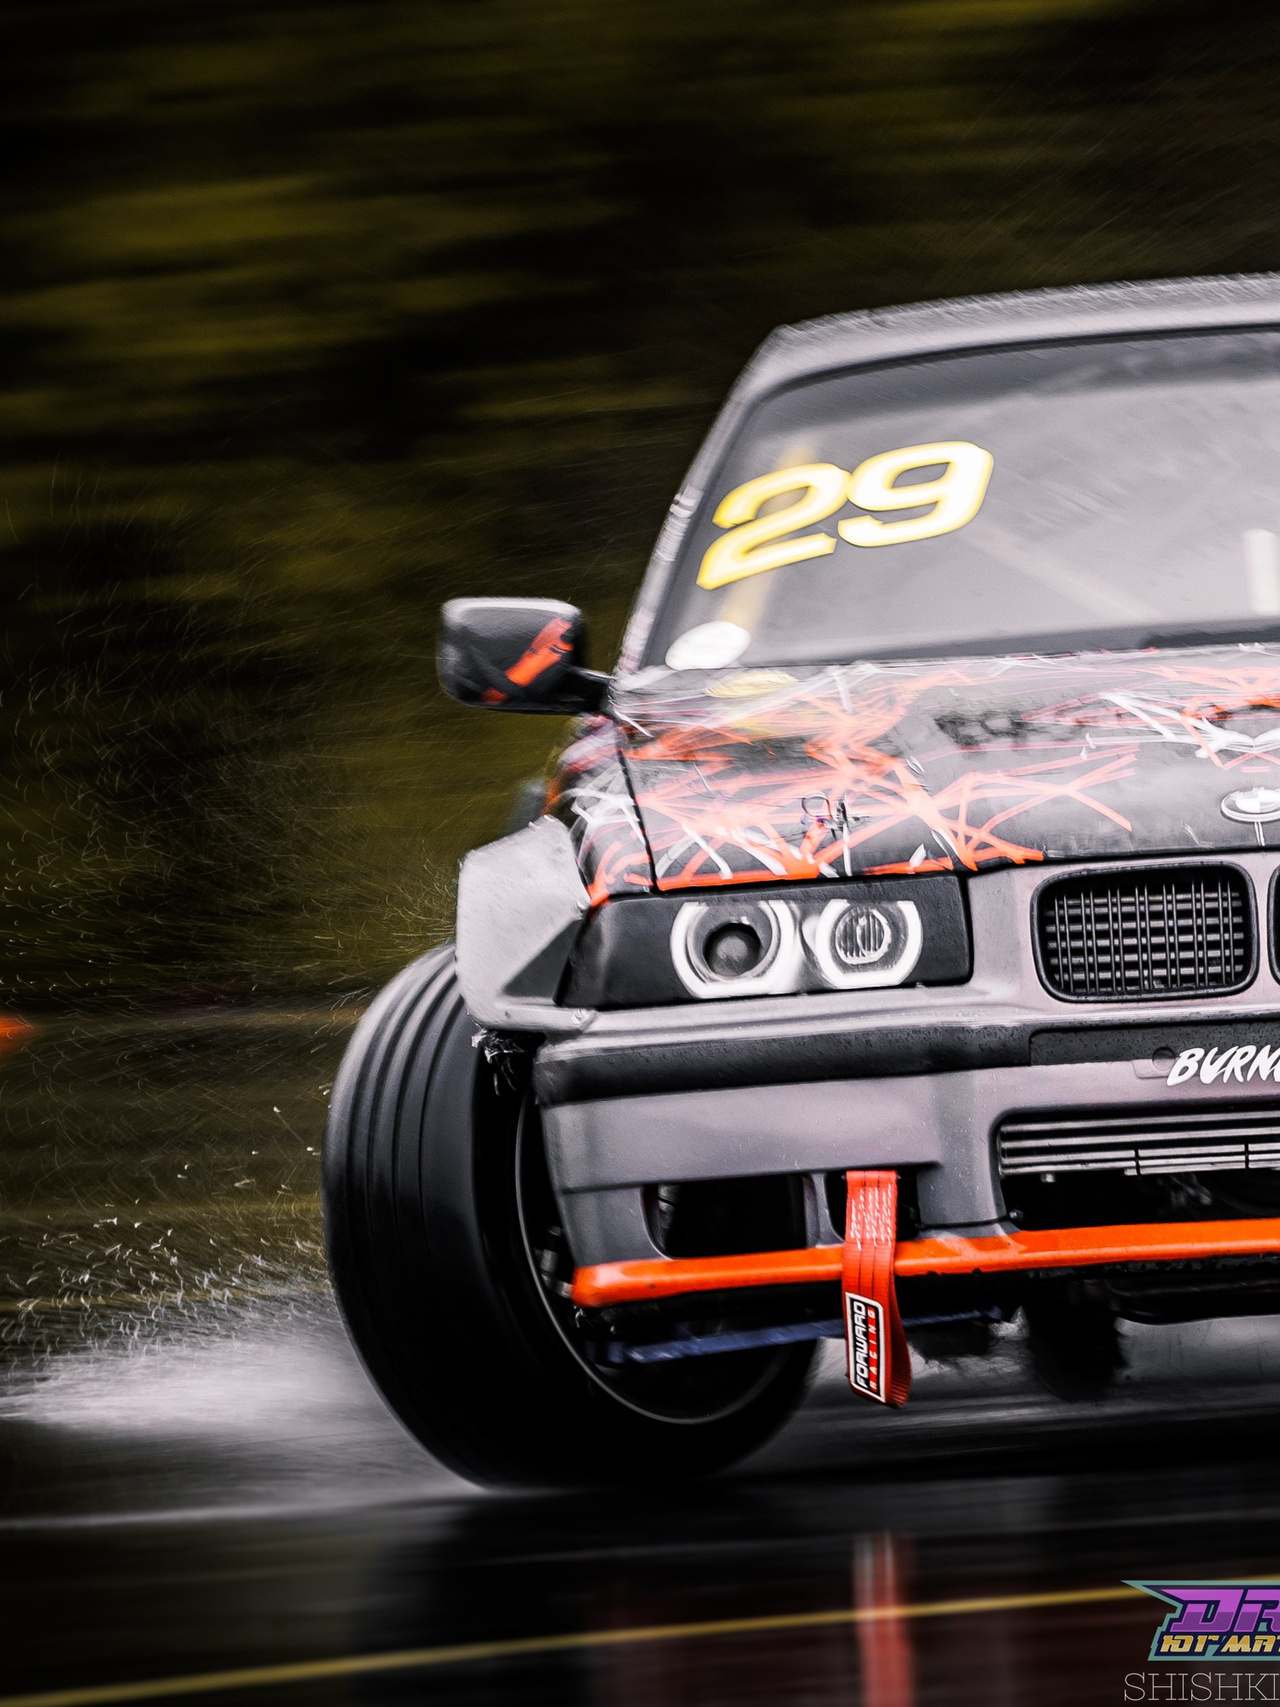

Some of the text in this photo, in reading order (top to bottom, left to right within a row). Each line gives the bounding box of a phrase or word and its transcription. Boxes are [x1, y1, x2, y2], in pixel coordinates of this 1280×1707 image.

[697, 441, 994, 590] 29
[853, 1300, 869, 1389] FORWARD
[867, 1308, 878, 1390] RACING
